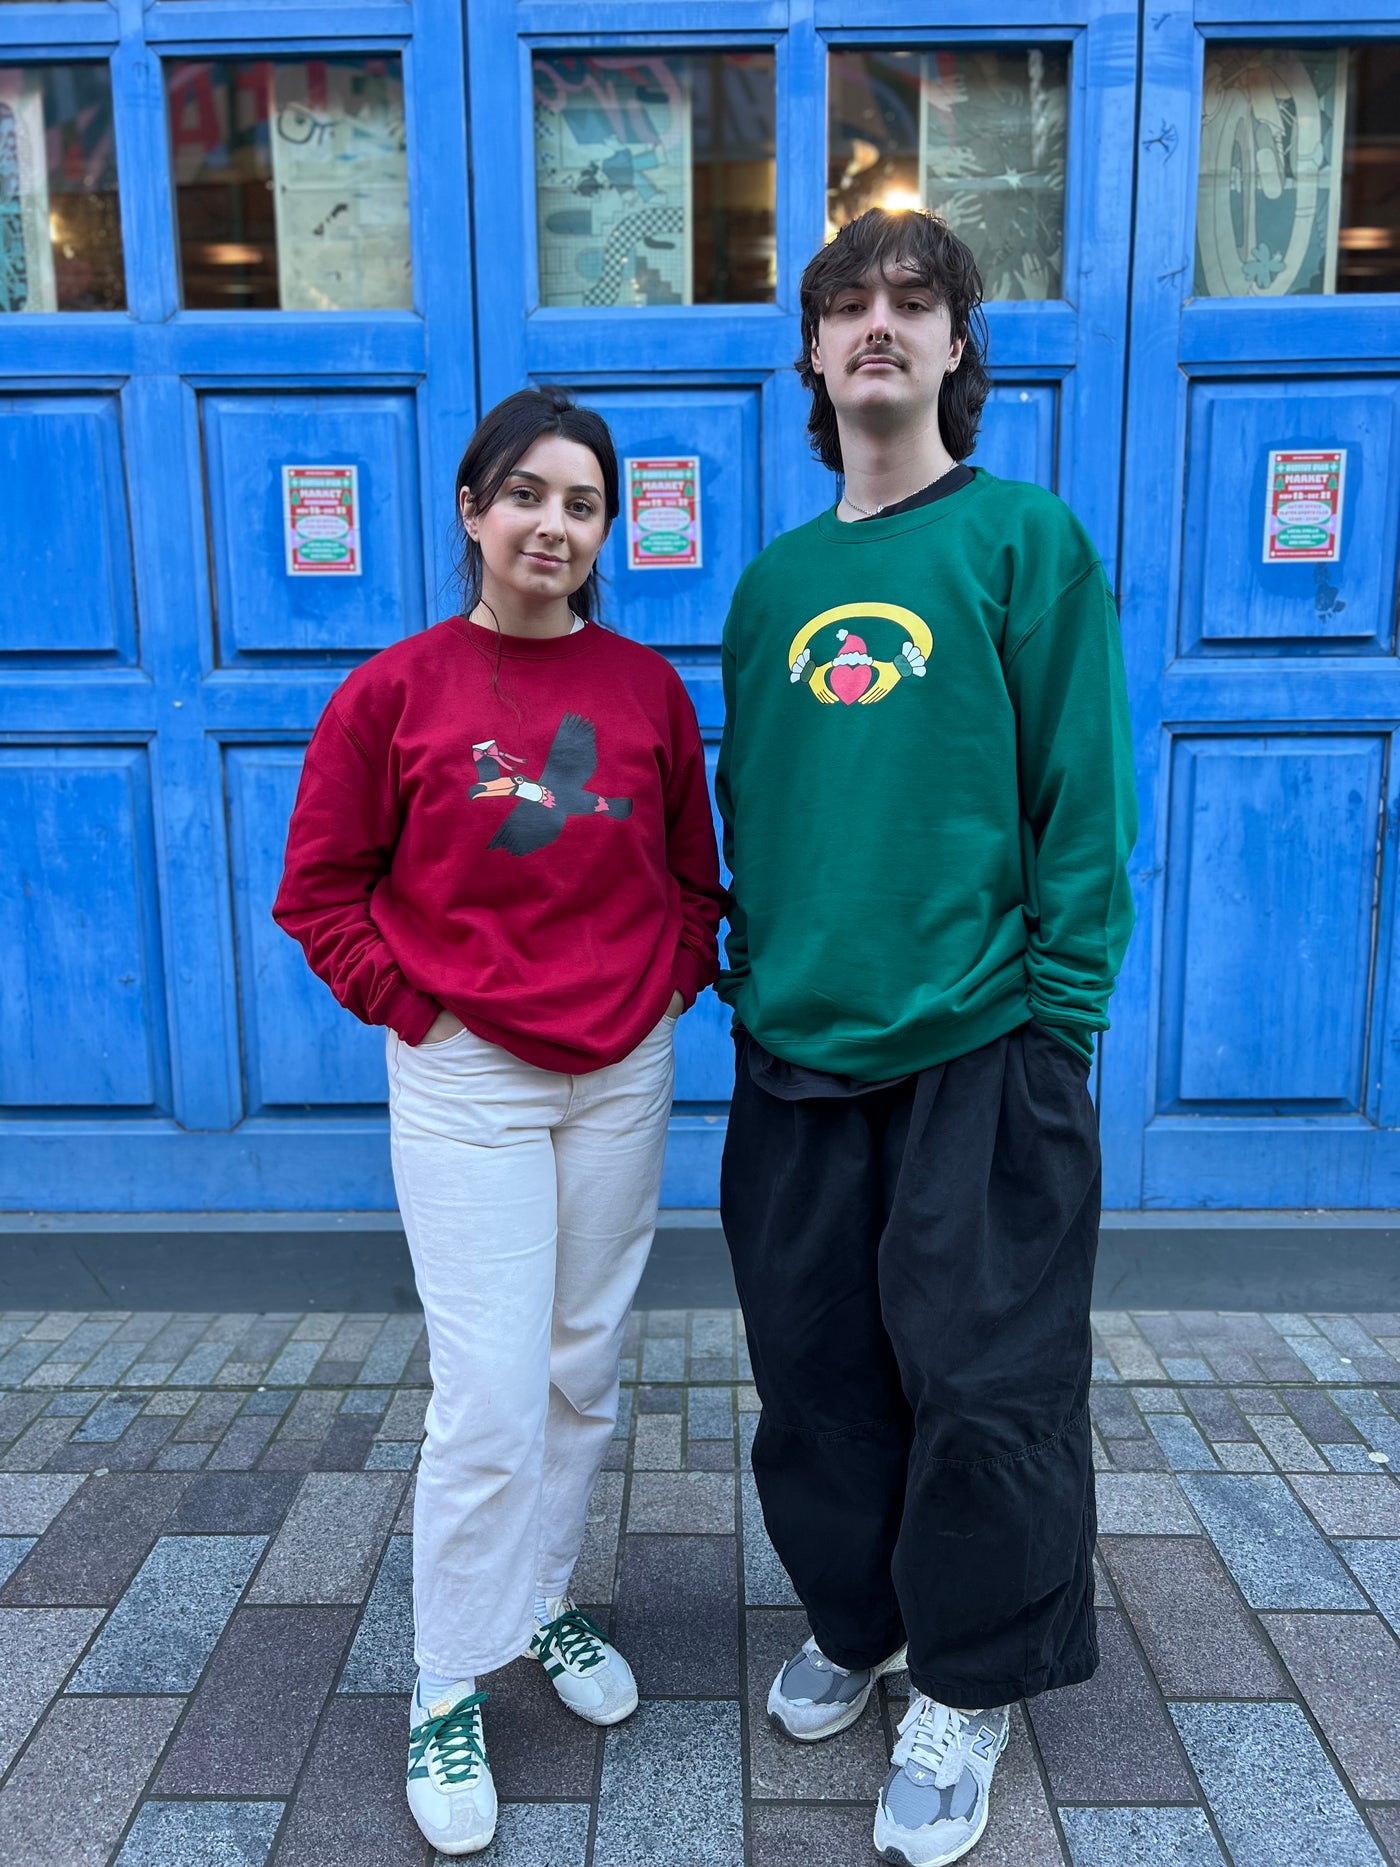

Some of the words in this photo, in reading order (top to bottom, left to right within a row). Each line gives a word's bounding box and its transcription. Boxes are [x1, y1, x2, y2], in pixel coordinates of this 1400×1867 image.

[1285, 474, 1329, 484] MARKET
[642, 481, 684, 490] MARKET
[300, 489, 342, 498] MARKET
